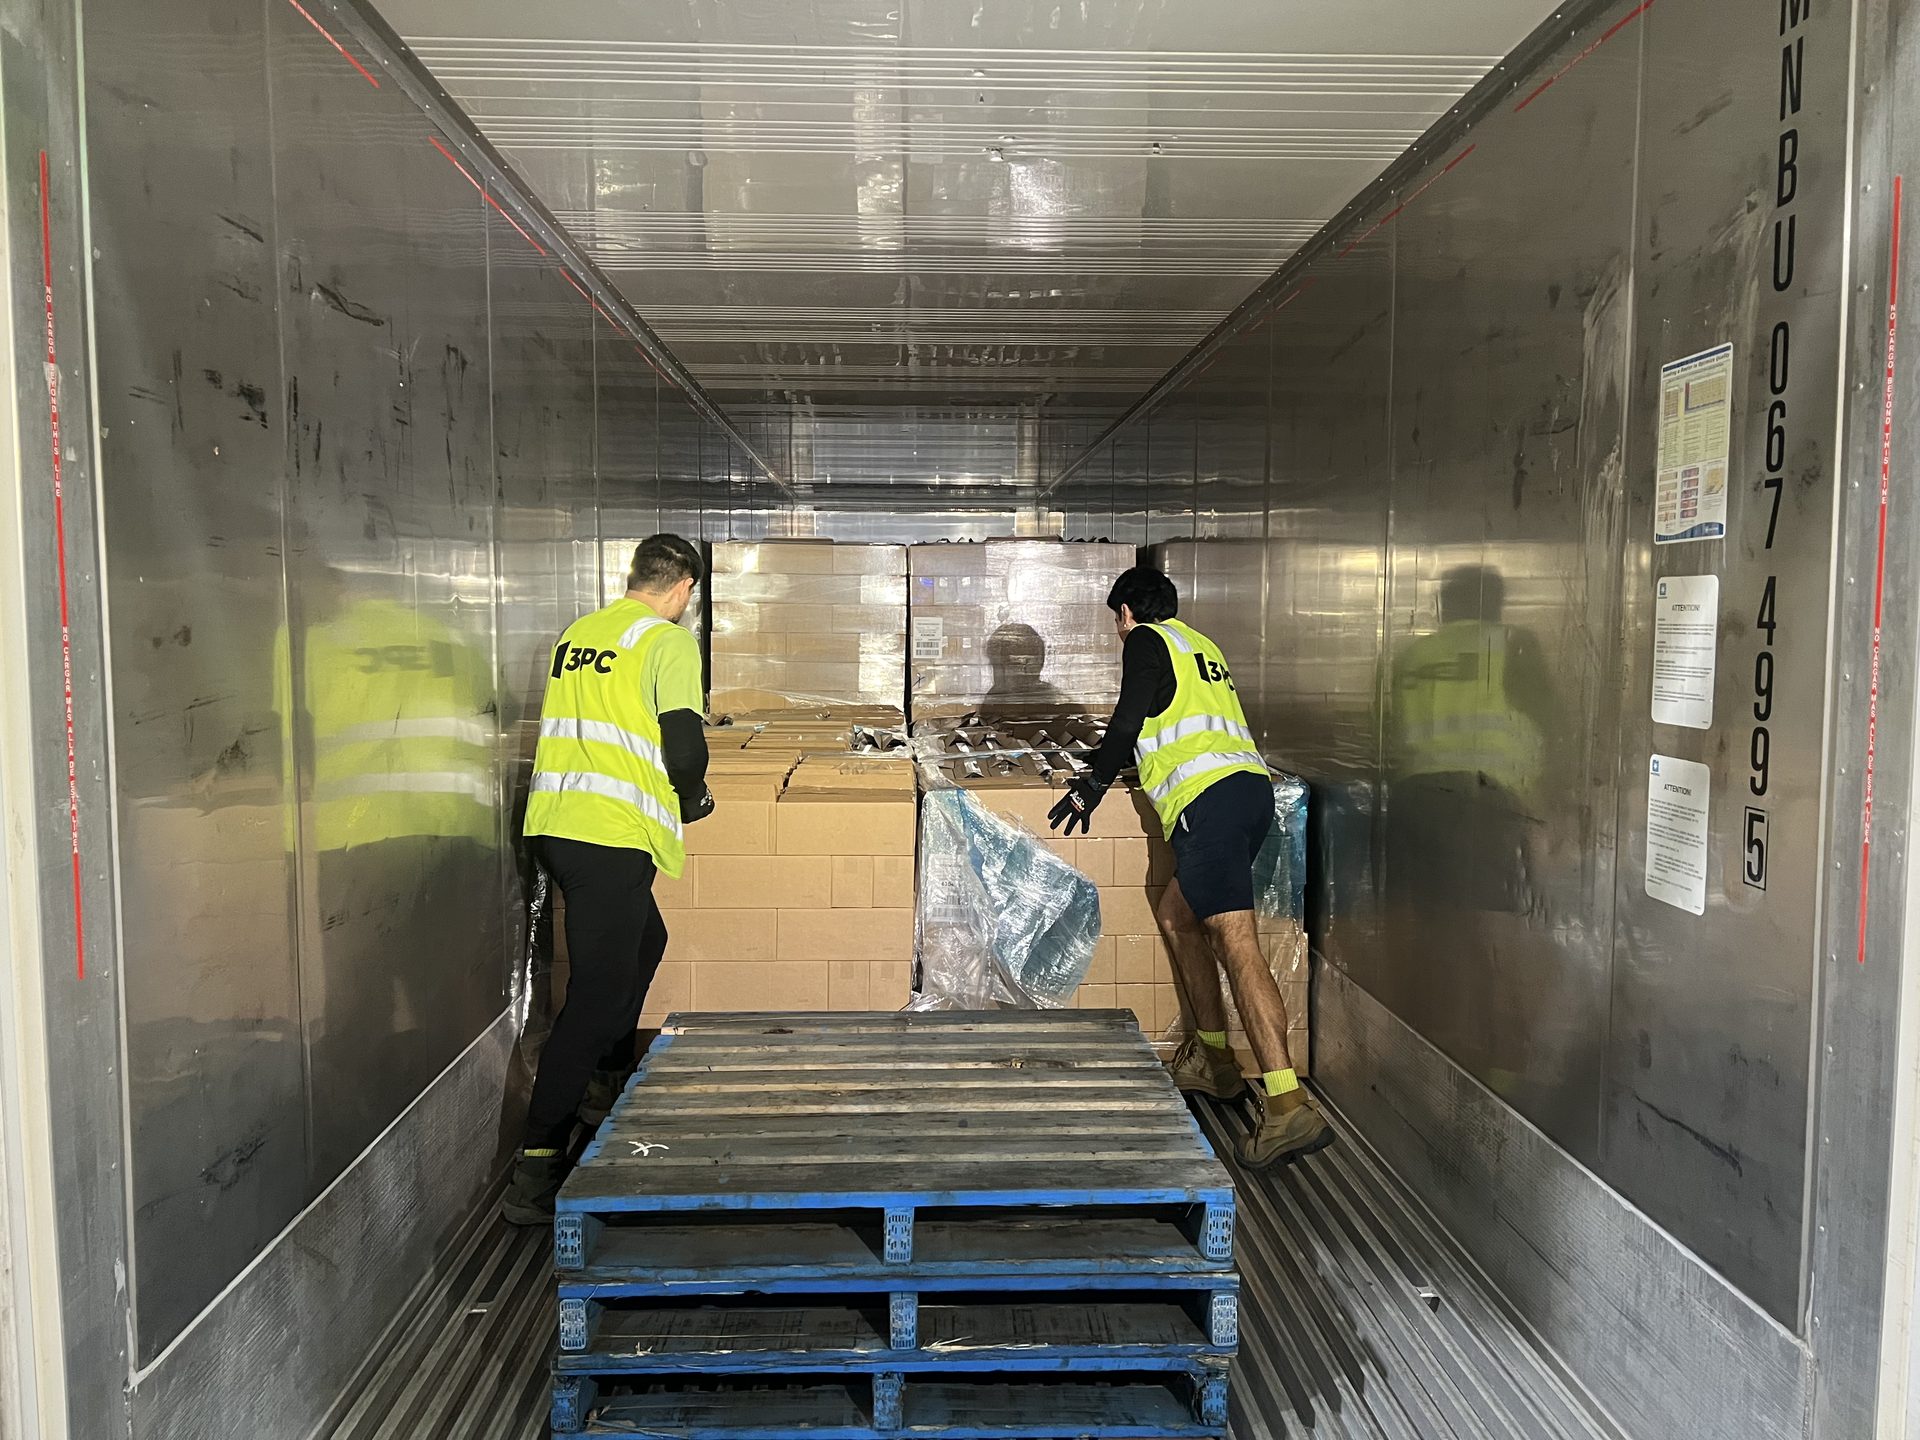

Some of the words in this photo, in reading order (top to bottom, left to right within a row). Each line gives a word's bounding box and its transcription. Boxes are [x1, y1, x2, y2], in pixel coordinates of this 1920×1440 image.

[45, 286, 52, 303] NO
[1889, 304, 1896, 320] NO
[1887, 328, 1896, 369] CARGO
[1885, 377, 1894, 425] BEYOND
[1763, 321, 1790, 549] 067
[1671, 603, 1701, 612] ATTENTION!
[62, 626, 69, 642] NO
[1874, 628, 1880, 641] NO
[63, 647, 71, 692] CARGAR
[564, 647, 618, 674] 3PC
[1871, 647, 1879, 689] CARGAR
[1749, 576, 1777, 796] 499
[69, 760, 75, 776] DE
[1868, 755, 1874, 769] DE
[1663, 783, 1692, 797] ATTENTION!
[1746, 812, 1765, 884] 5
